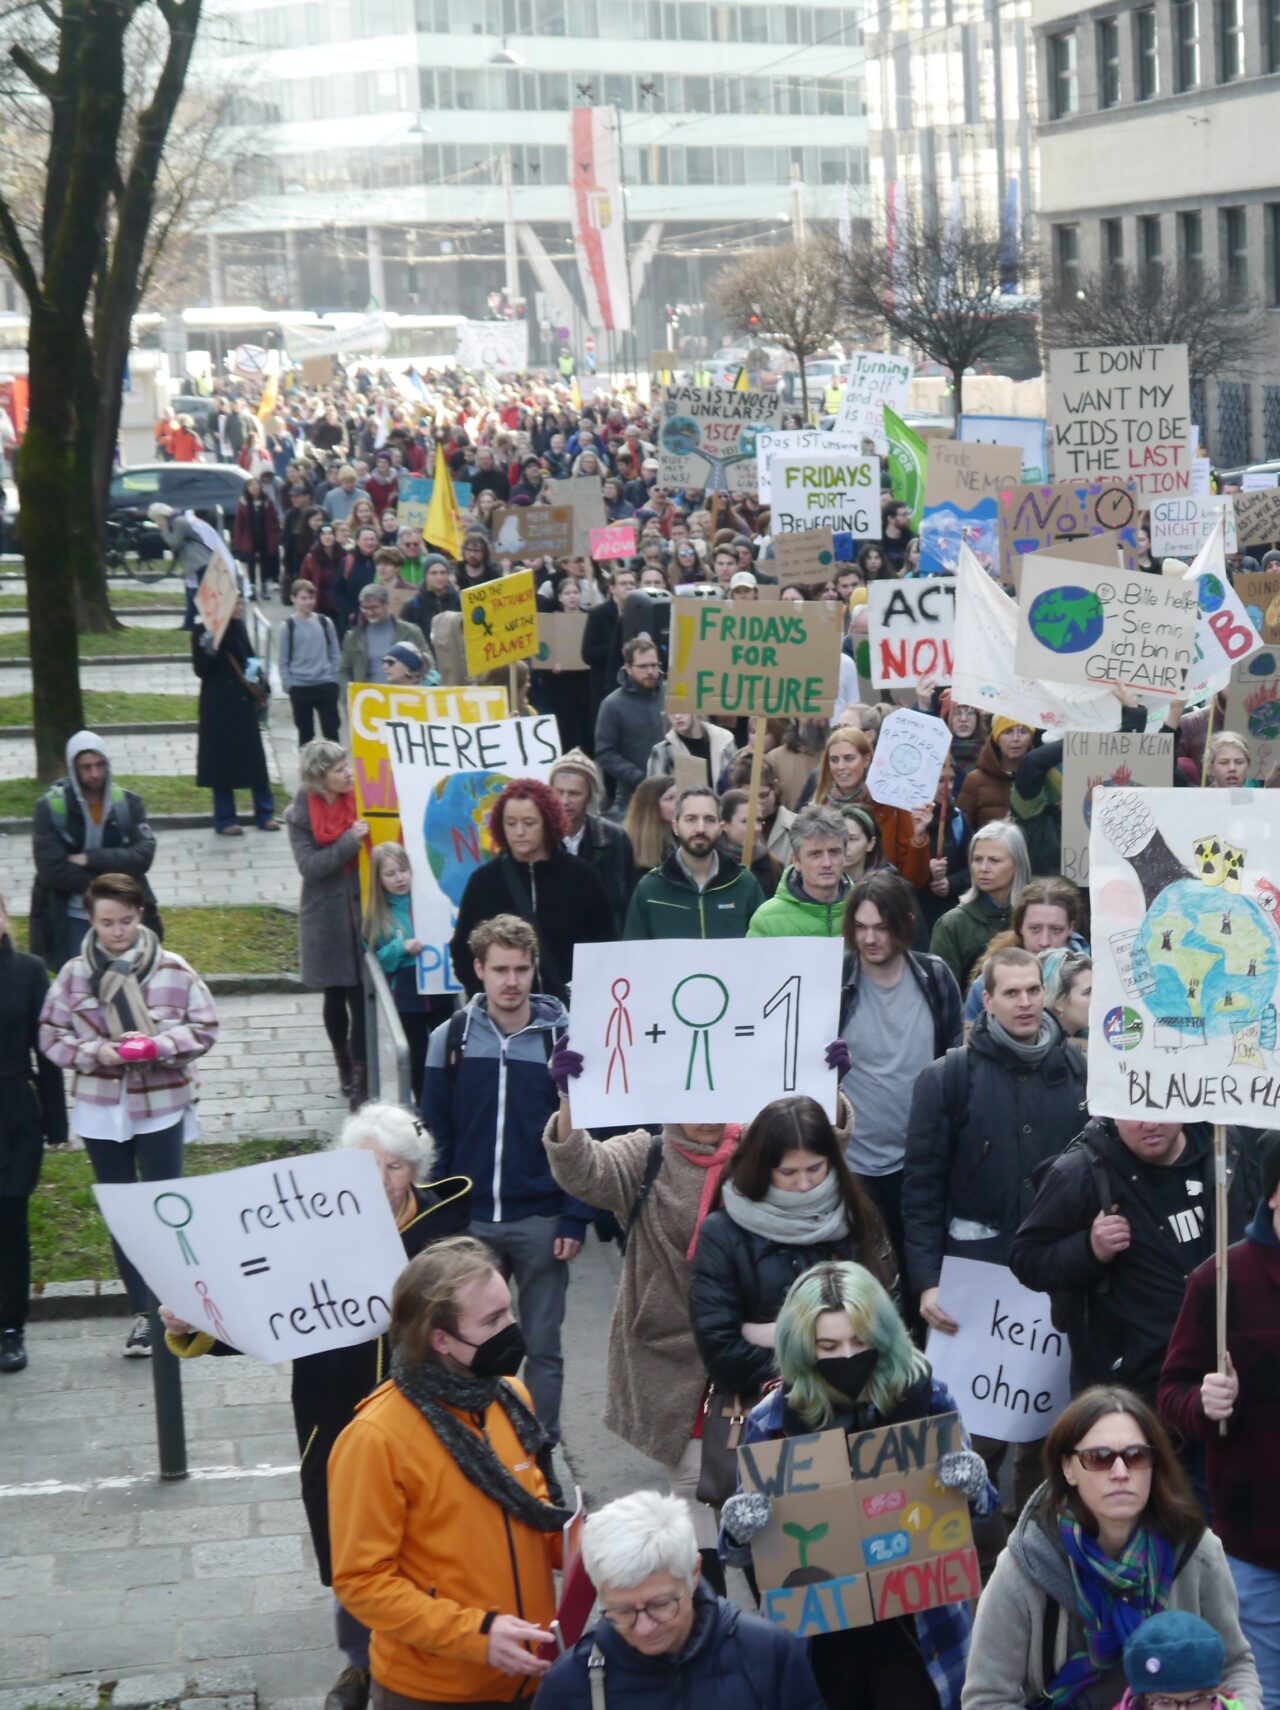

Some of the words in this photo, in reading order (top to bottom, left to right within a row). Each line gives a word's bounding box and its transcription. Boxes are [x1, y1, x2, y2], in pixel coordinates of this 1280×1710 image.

[857, 354, 909, 385] Turning
[1073, 351, 1090, 373] I
[1100, 347, 1164, 373] DON'T
[667, 387, 702, 402] WAS
[706, 390, 738, 404] IST
[739, 391, 779, 410] NOCH
[846, 391, 872, 405] and
[852, 375, 866, 388] it
[868, 376, 895, 395] off
[1063, 387, 1132, 414] WANT
[1139, 384, 1175, 408] MY
[844, 408, 859, 421] is
[761, 435, 790, 449] Das
[796, 433, 823, 448] IST
[1055, 420, 1117, 446] KIDS
[1125, 419, 1153, 443] TO
[1158, 417, 1187, 440] BE
[892, 448, 914, 474] FOR
[1066, 449, 1120, 473] THE
[1127, 445, 1187, 469] LAST
[784, 463, 872, 490] FRIDAYS
[806, 491, 857, 511] FORT-
[1154, 500, 1199, 521] GELD
[1233, 491, 1270, 516] KLIMA
[778, 509, 870, 534] BEWEGUNG
[1155, 522, 1200, 538] NICHT
[468, 590, 487, 604] END
[488, 583, 503, 596] THE
[1124, 582, 1159, 606] Bitte
[700, 606, 808, 645] FRIDAYS
[1121, 609, 1152, 634] Sie
[482, 632, 534, 663] PLANET
[731, 644, 779, 667] FOR
[1111, 635, 1135, 657] ich
[1141, 636, 1168, 659] bin
[1174, 647, 1190, 663] in
[1085, 654, 1189, 691] GEFAHR!
[695, 670, 824, 715] FUTURE
[385, 720, 508, 769] THERE
[514, 718, 558, 766] IS
[1066, 731, 1089, 757] ICH
[1098, 732, 1132, 756] HAB
[1138, 735, 1173, 757] KEIN
[239, 1170, 362, 1235] retten
[268, 1278, 392, 1341] retten
[990, 1299, 1063, 1358] kein
[971, 1363, 1055, 1415] ohne
[738, 1432, 821, 1498] WE
[851, 1414, 961, 1481] CAN'T
[870, 1533, 908, 1561] 20
[765, 1575, 859, 1638] EAT
[877, 1548, 981, 1621] MONEY
